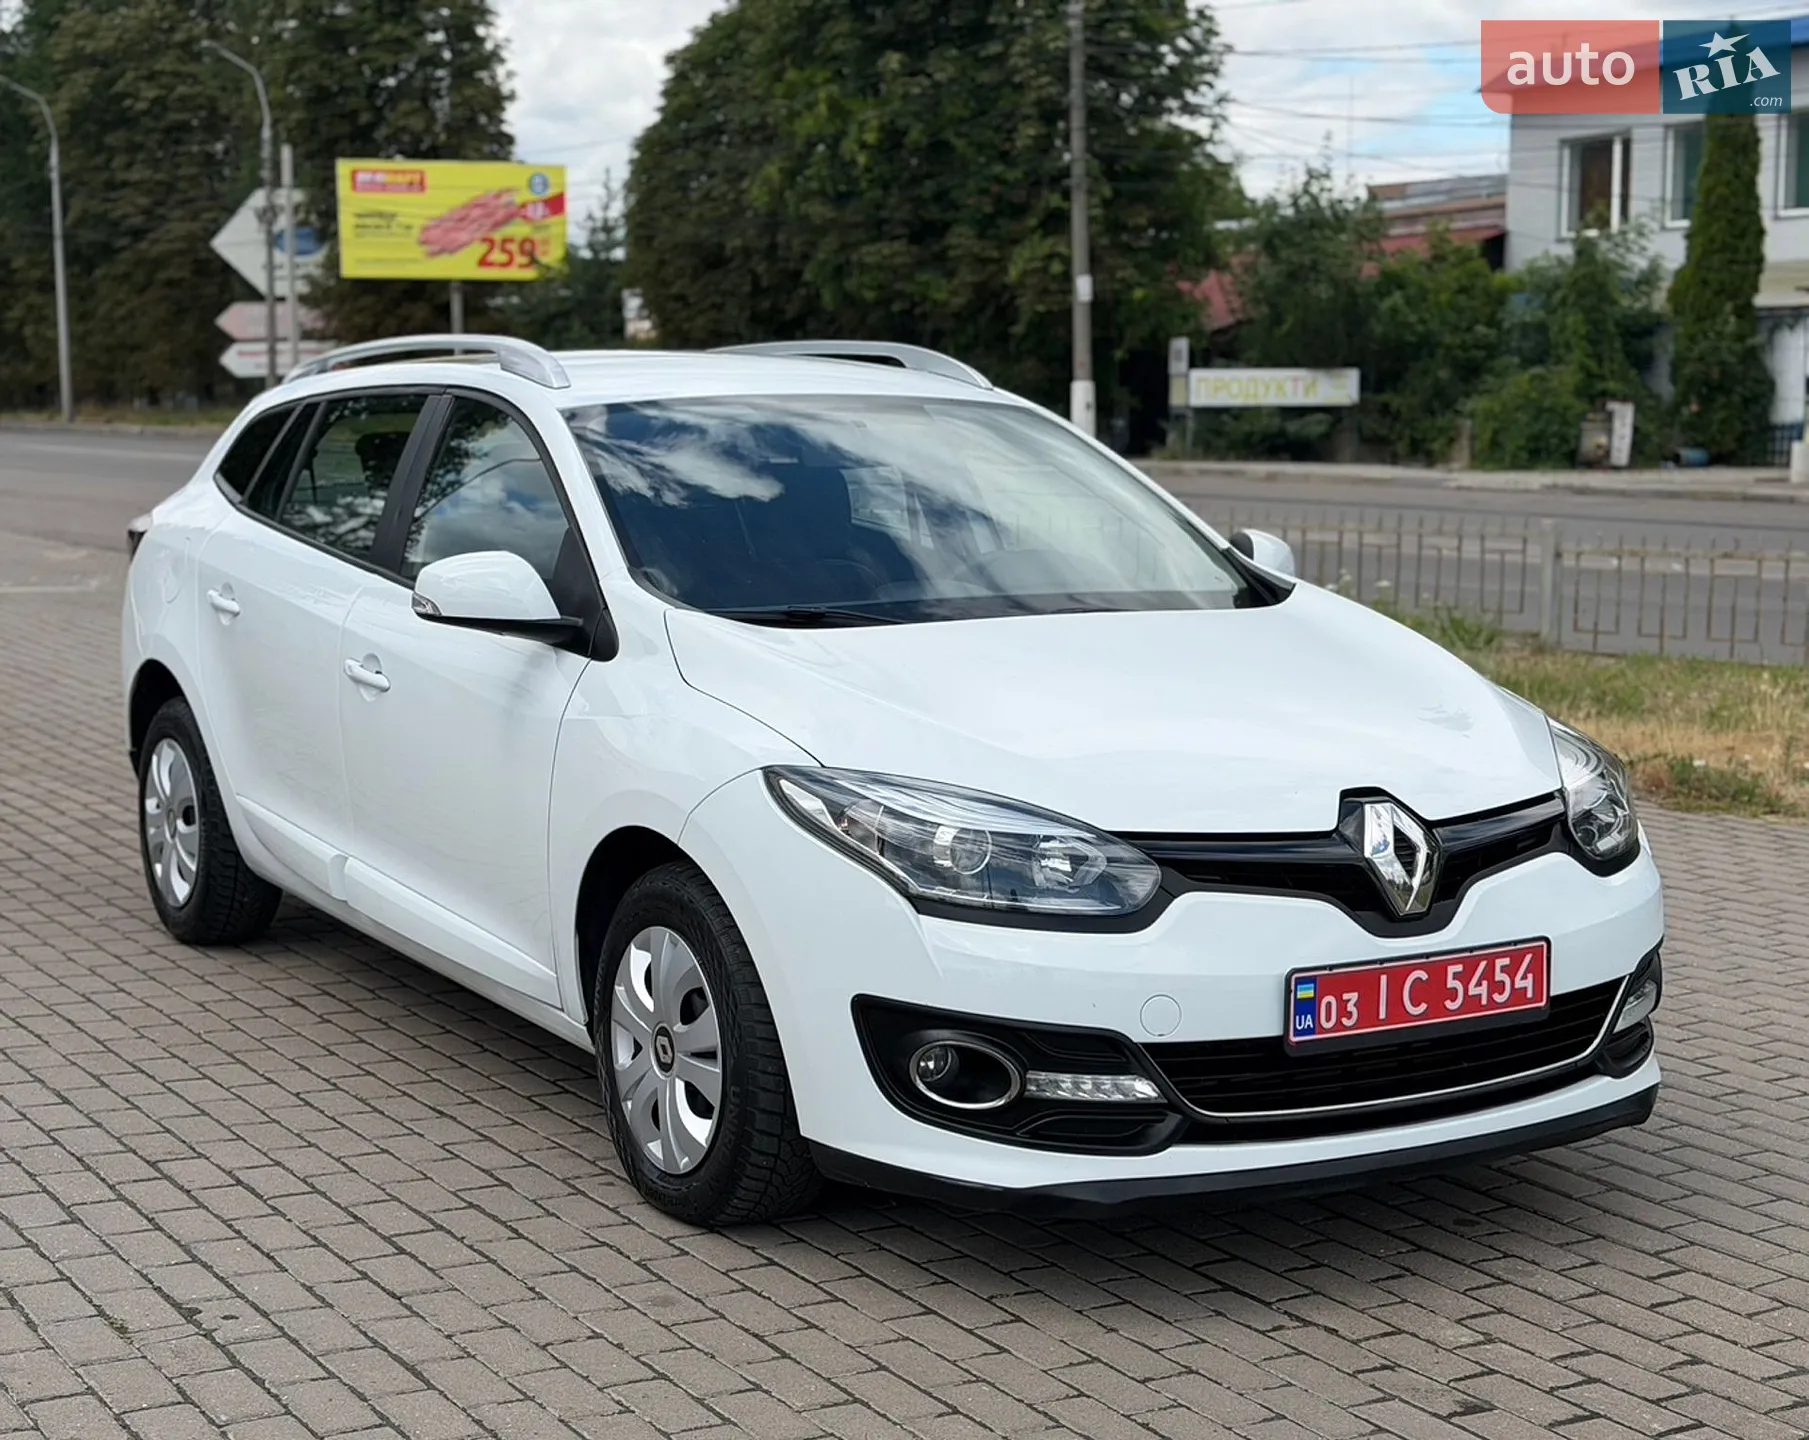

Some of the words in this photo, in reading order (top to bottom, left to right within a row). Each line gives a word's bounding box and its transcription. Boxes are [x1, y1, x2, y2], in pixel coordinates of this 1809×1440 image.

[478, 237, 536, 268] 259
[1196, 375, 1319, 403] ПРОДУКТИ
[1319, 991, 1360, 1030] 03
[1444, 953, 1534, 1011] 5454
[1295, 1015, 1314, 1030] UA
